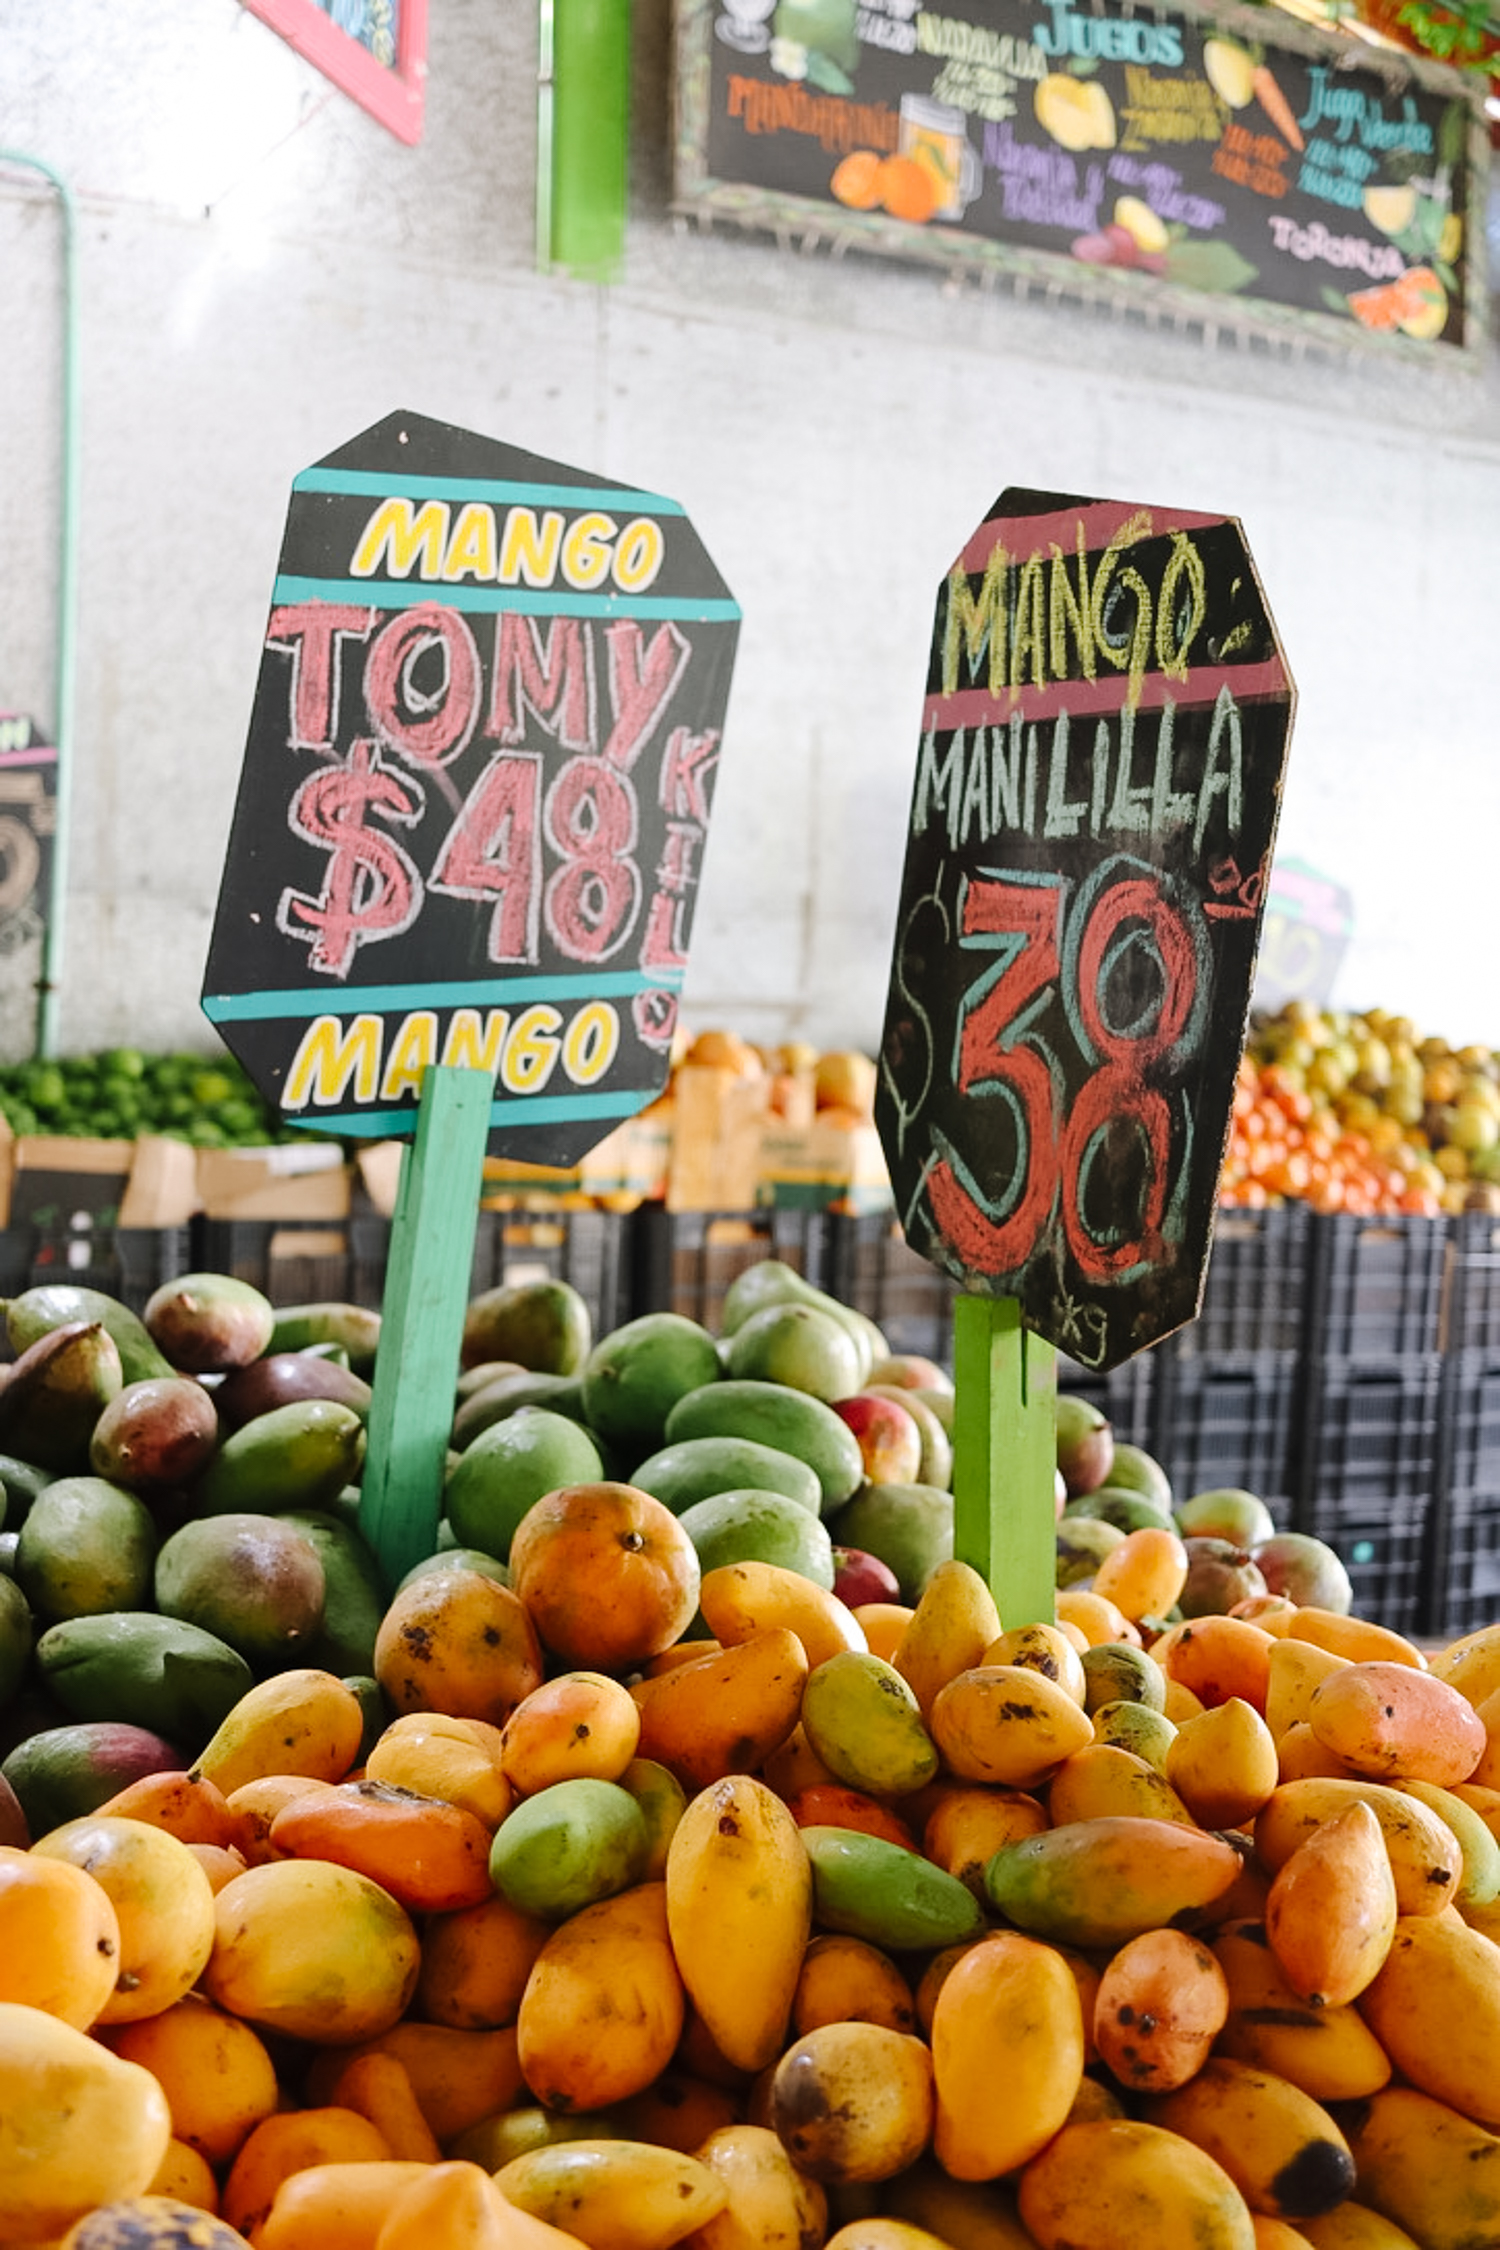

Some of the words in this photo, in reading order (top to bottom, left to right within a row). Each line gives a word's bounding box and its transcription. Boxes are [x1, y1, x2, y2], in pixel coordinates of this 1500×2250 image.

[349, 496, 665, 593] MANGO
[942, 510, 1207, 715] MANGO
[265, 600, 692, 770] TOMY
[275, 736, 644, 982] $48
[279, 1000, 621, 1110] MANGO
